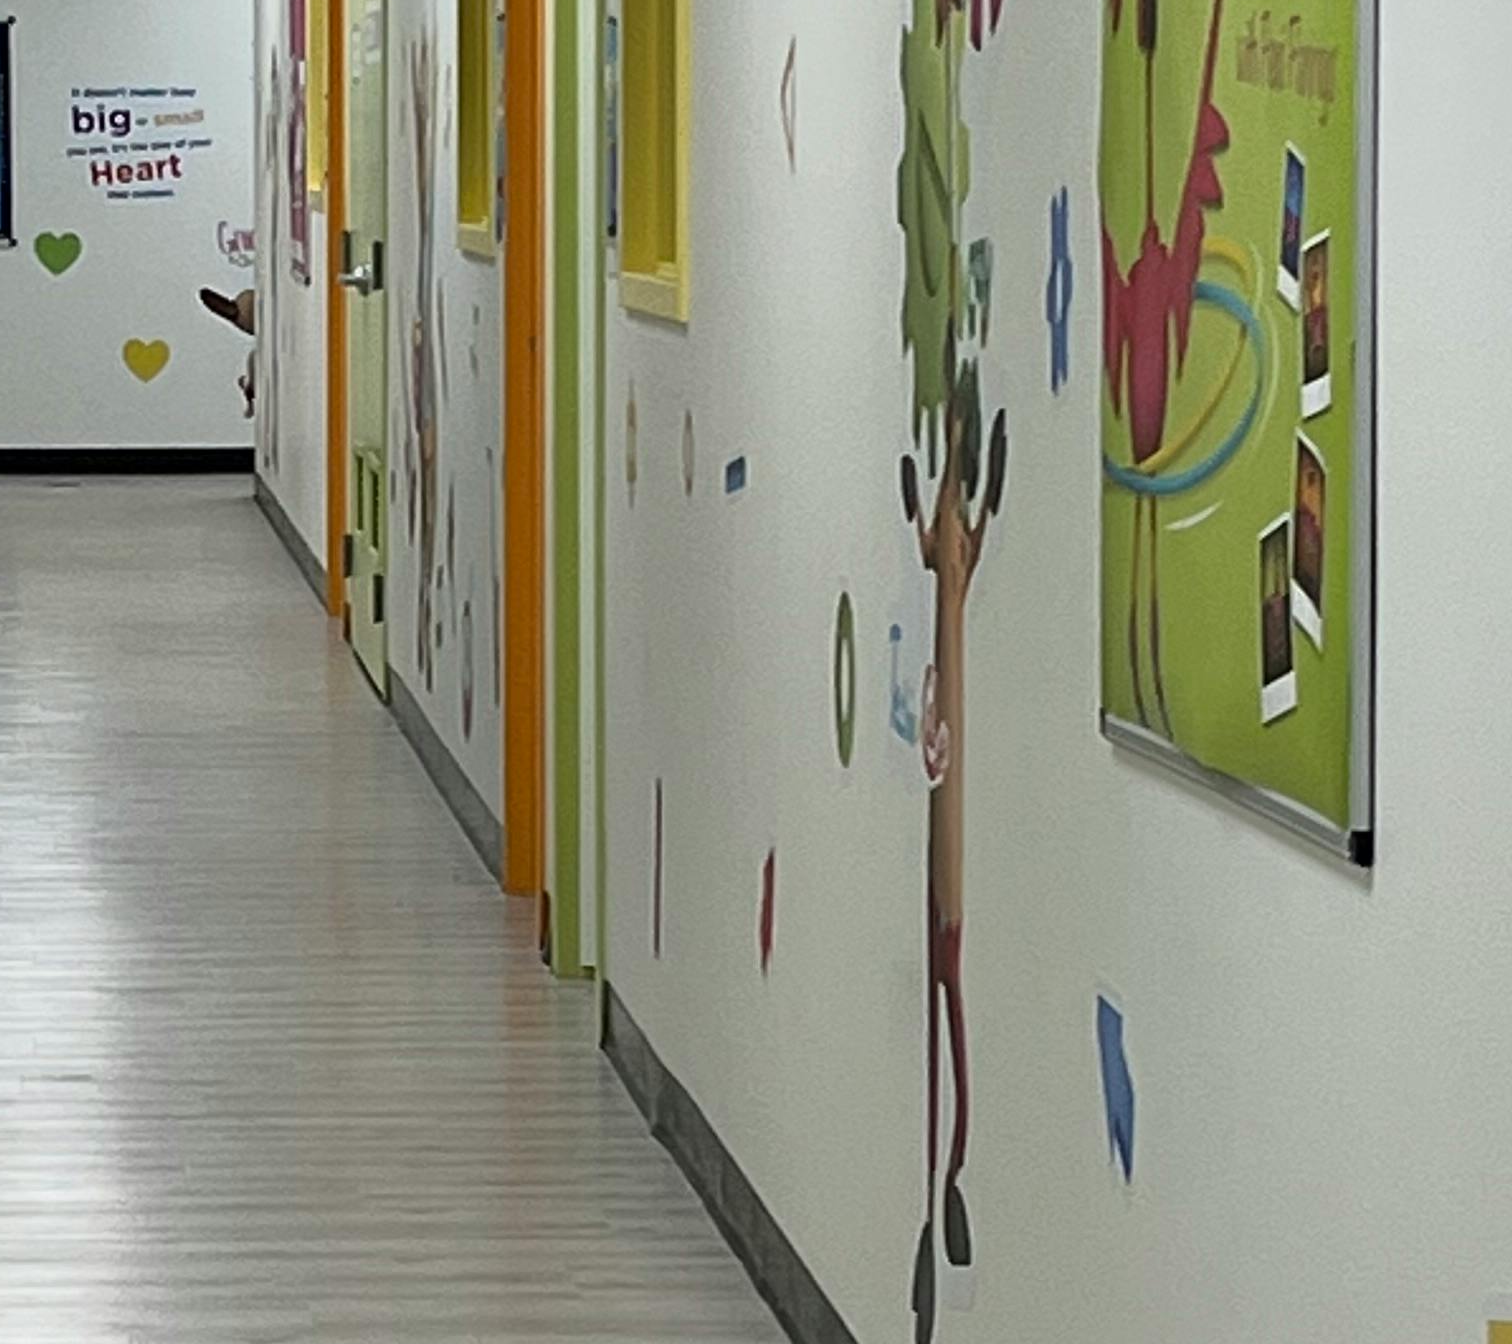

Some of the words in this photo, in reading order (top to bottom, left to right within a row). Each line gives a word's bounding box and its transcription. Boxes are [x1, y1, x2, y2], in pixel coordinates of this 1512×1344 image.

[71, 104, 131, 137] big
[154, 110, 204, 127] small
[90, 154, 182, 186] Heart
